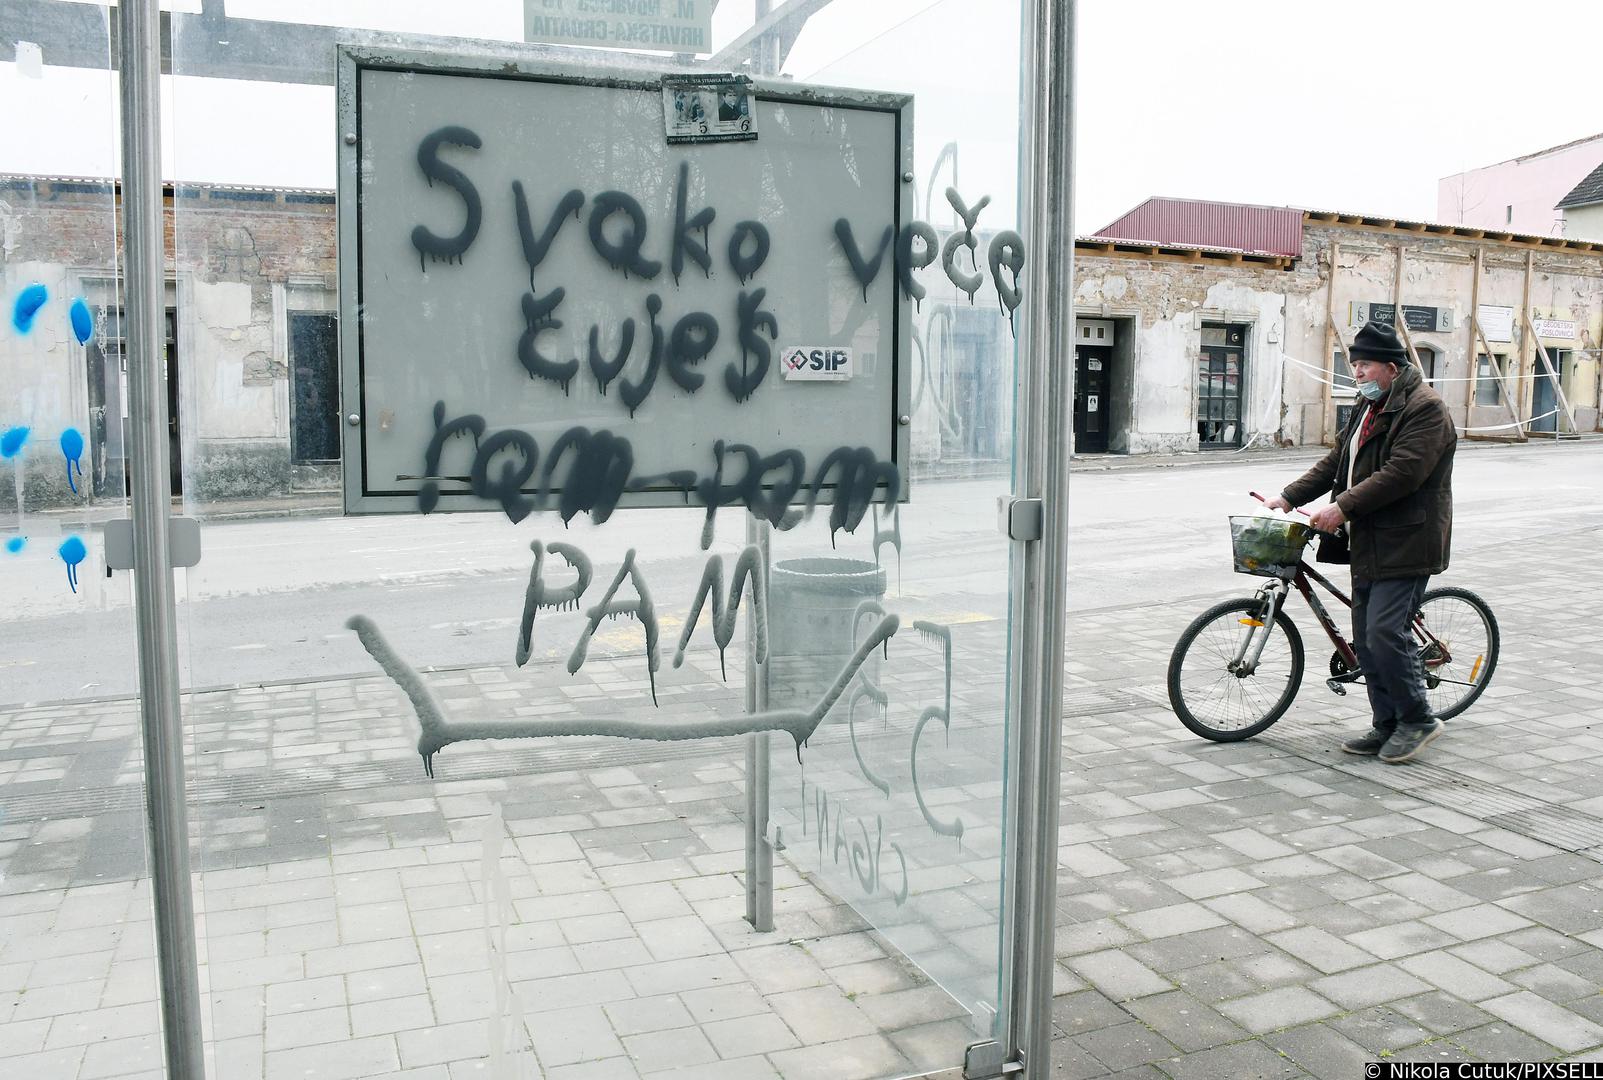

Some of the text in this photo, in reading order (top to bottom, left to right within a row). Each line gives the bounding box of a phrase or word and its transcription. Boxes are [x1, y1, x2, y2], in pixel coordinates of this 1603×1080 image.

[699, 120, 708, 134] 5
[741, 119, 750, 132] 6
[809, 349, 848, 371] SIP
[515, 538, 769, 706] PAM
